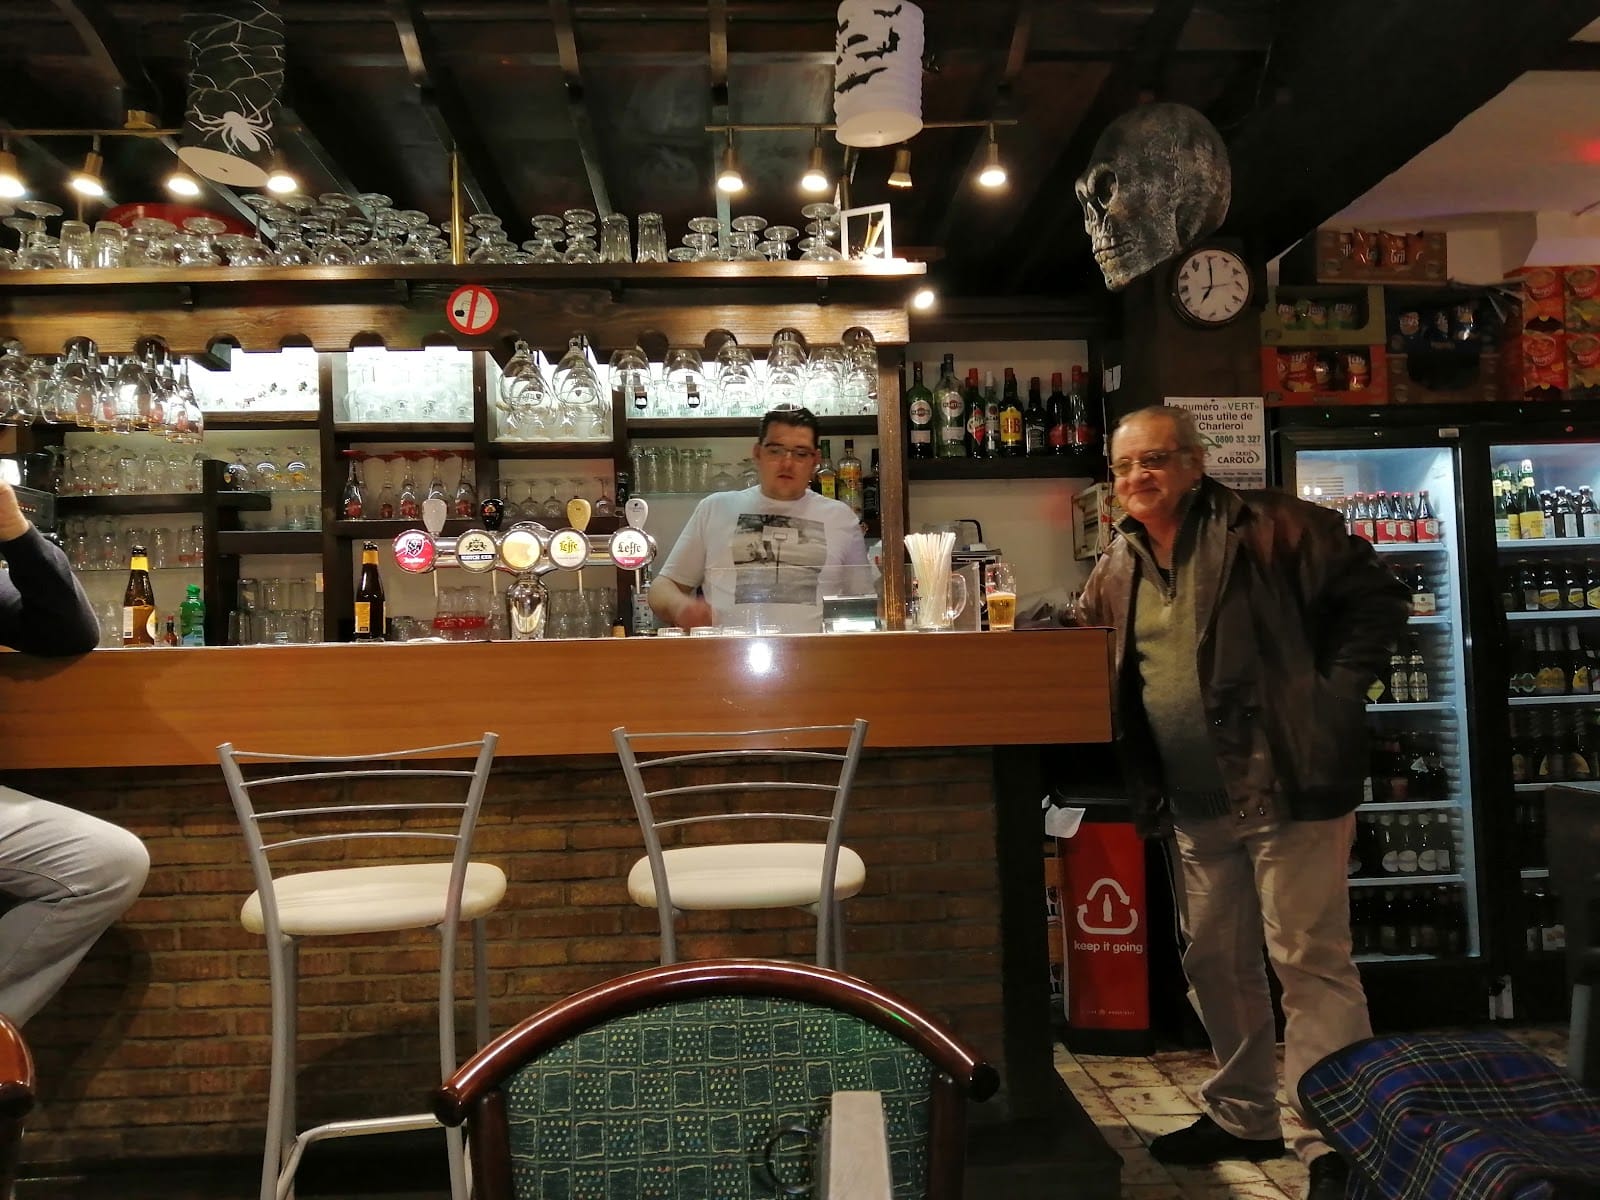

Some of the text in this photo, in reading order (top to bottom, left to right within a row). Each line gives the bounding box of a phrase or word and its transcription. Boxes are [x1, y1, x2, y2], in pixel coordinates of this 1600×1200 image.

[1216, 412, 1238, 421] utile
[1240, 412, 1253, 421] de
[1198, 422, 1244, 431] Charleroi
[1215, 435, 1261, 443] 0800 32 327
[1217, 456, 1254, 464] CAROLO
[559, 540, 578, 554] Leffe
[617, 541, 642, 555] Leffe
[1073, 940, 1143, 954] keep it going
